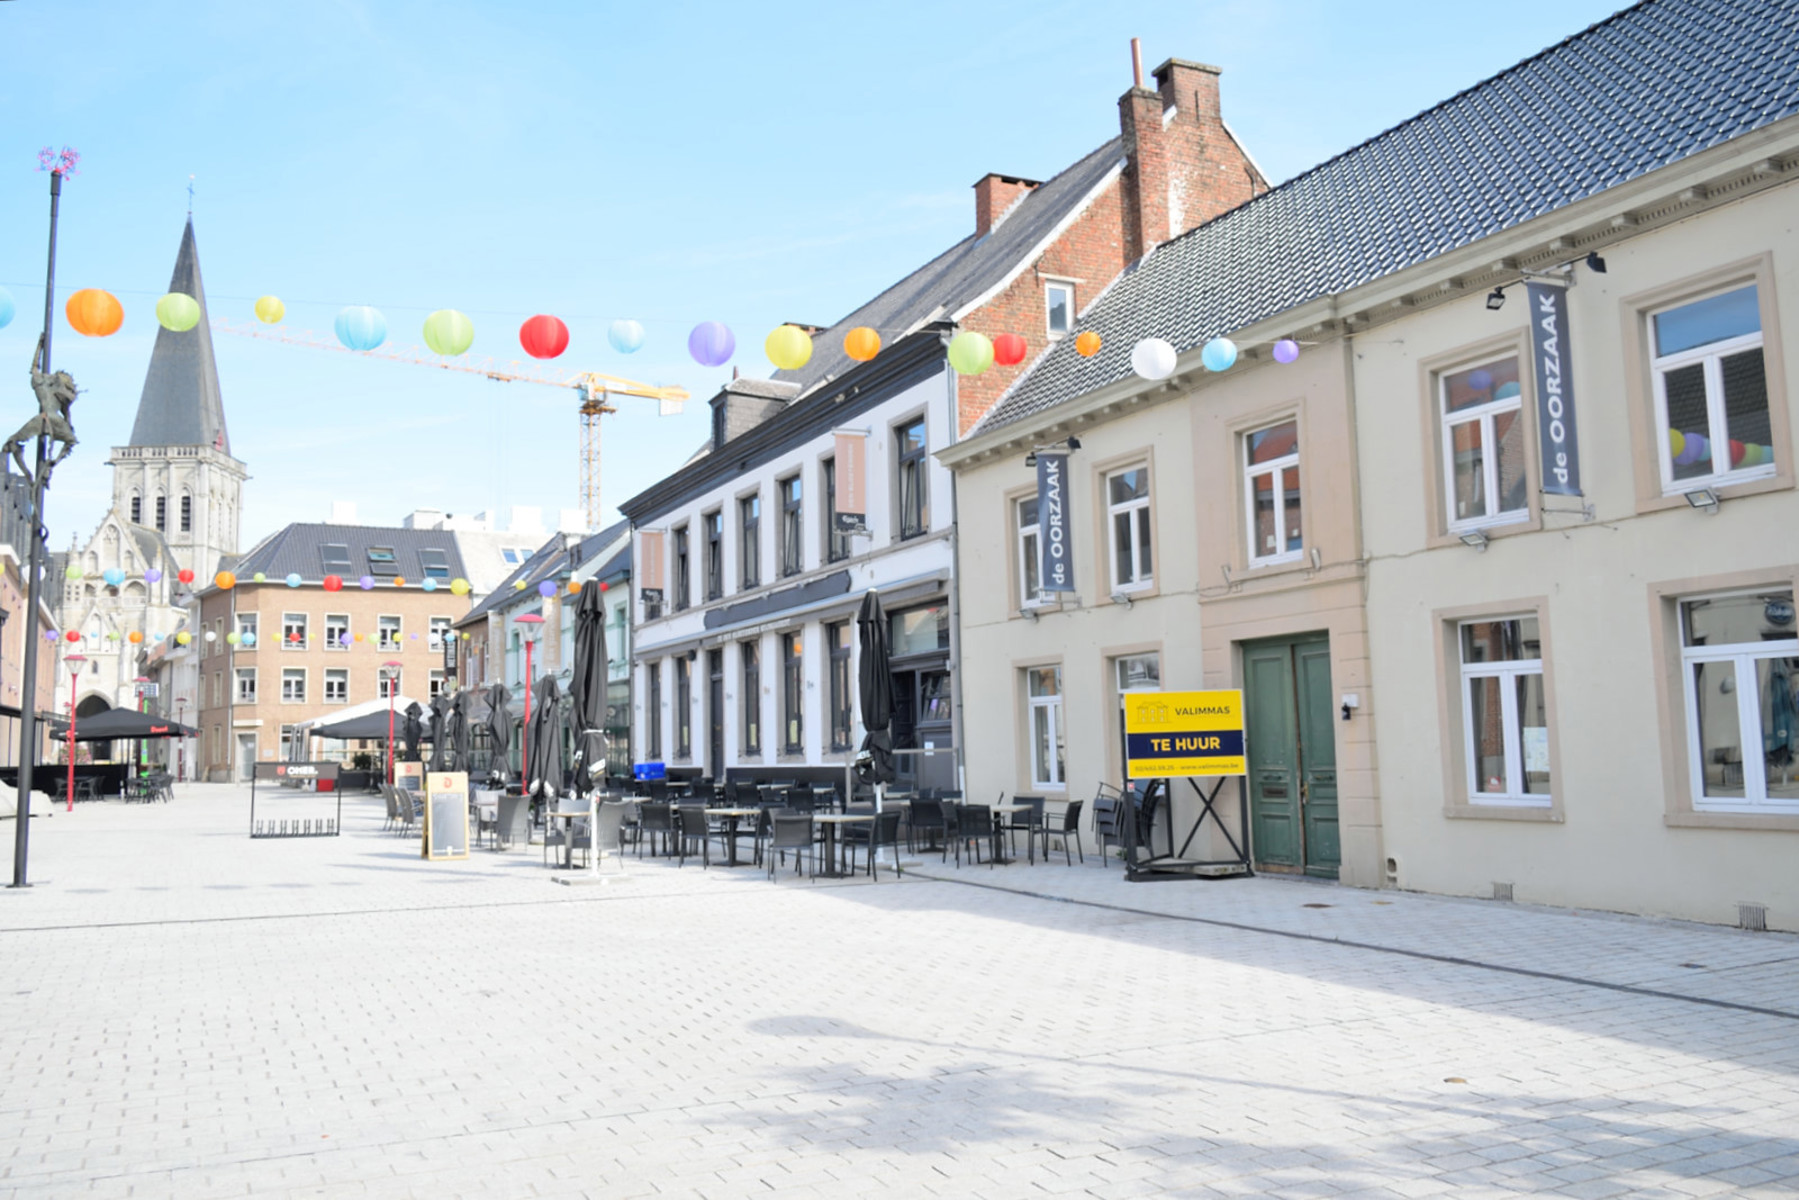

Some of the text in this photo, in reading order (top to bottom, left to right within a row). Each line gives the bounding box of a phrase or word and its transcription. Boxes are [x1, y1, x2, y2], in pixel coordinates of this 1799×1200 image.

[1539, 293, 1569, 484] de OORZAAK
[1046, 459, 1065, 584] de OORZAAK
[1150, 736, 1221, 752] TE HUUR
[1174, 706, 1231, 716] VALIMMAS
